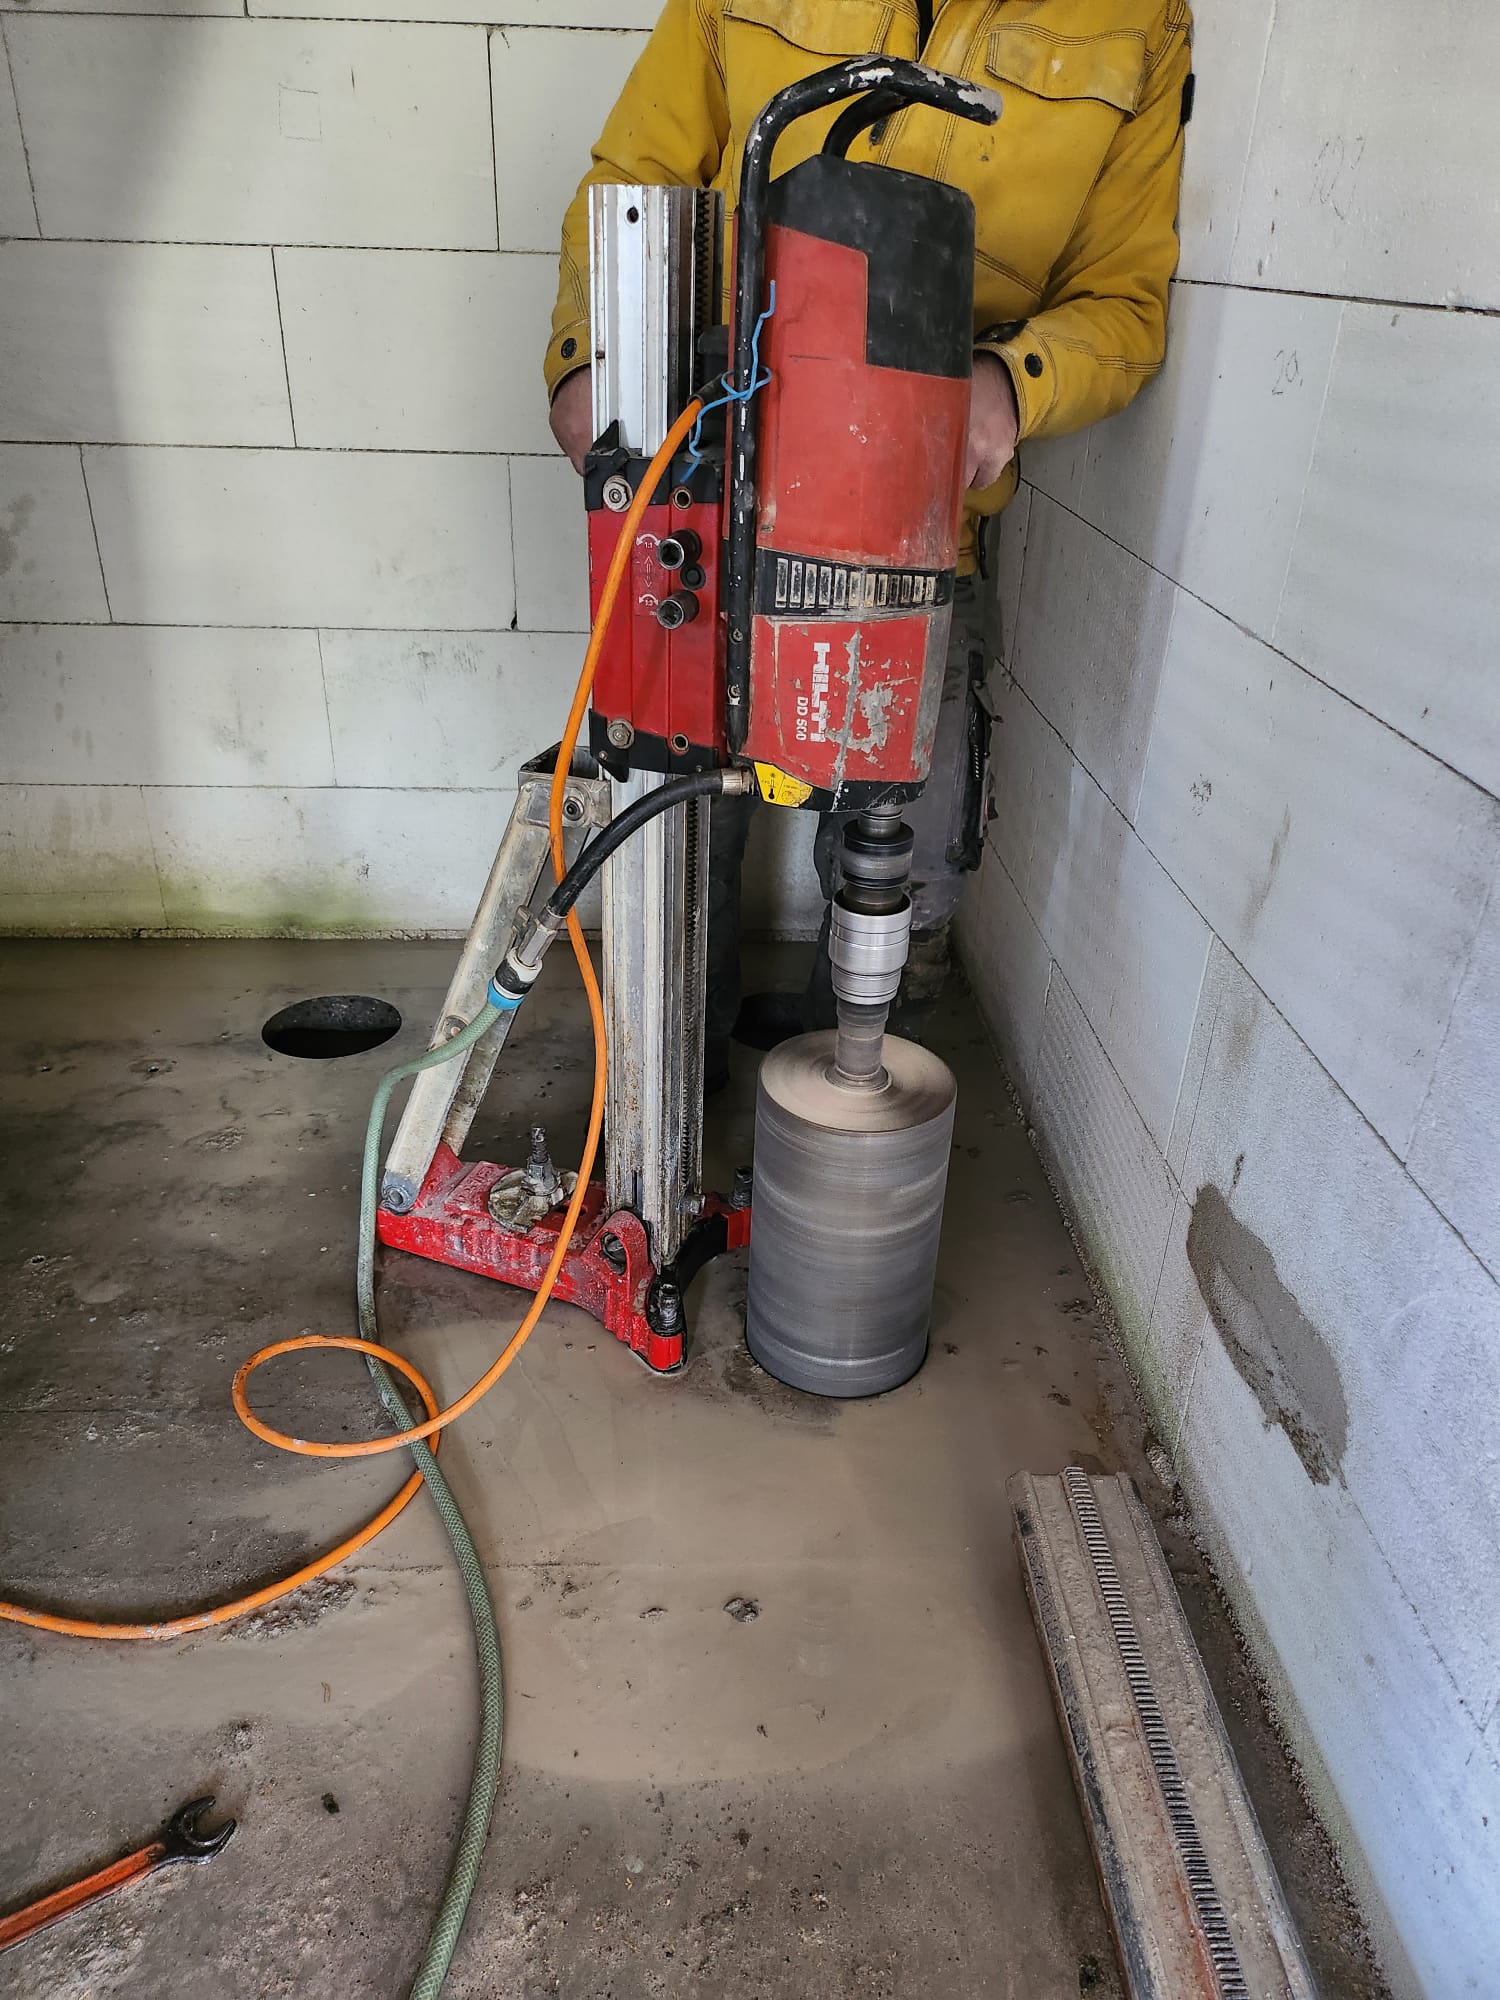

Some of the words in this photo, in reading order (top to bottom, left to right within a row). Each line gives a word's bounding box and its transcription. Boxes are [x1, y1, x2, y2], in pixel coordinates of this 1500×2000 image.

[810, 642, 830, 743] HILTI
[796, 696, 809, 716] DD
[795, 718, 808, 741] 500
